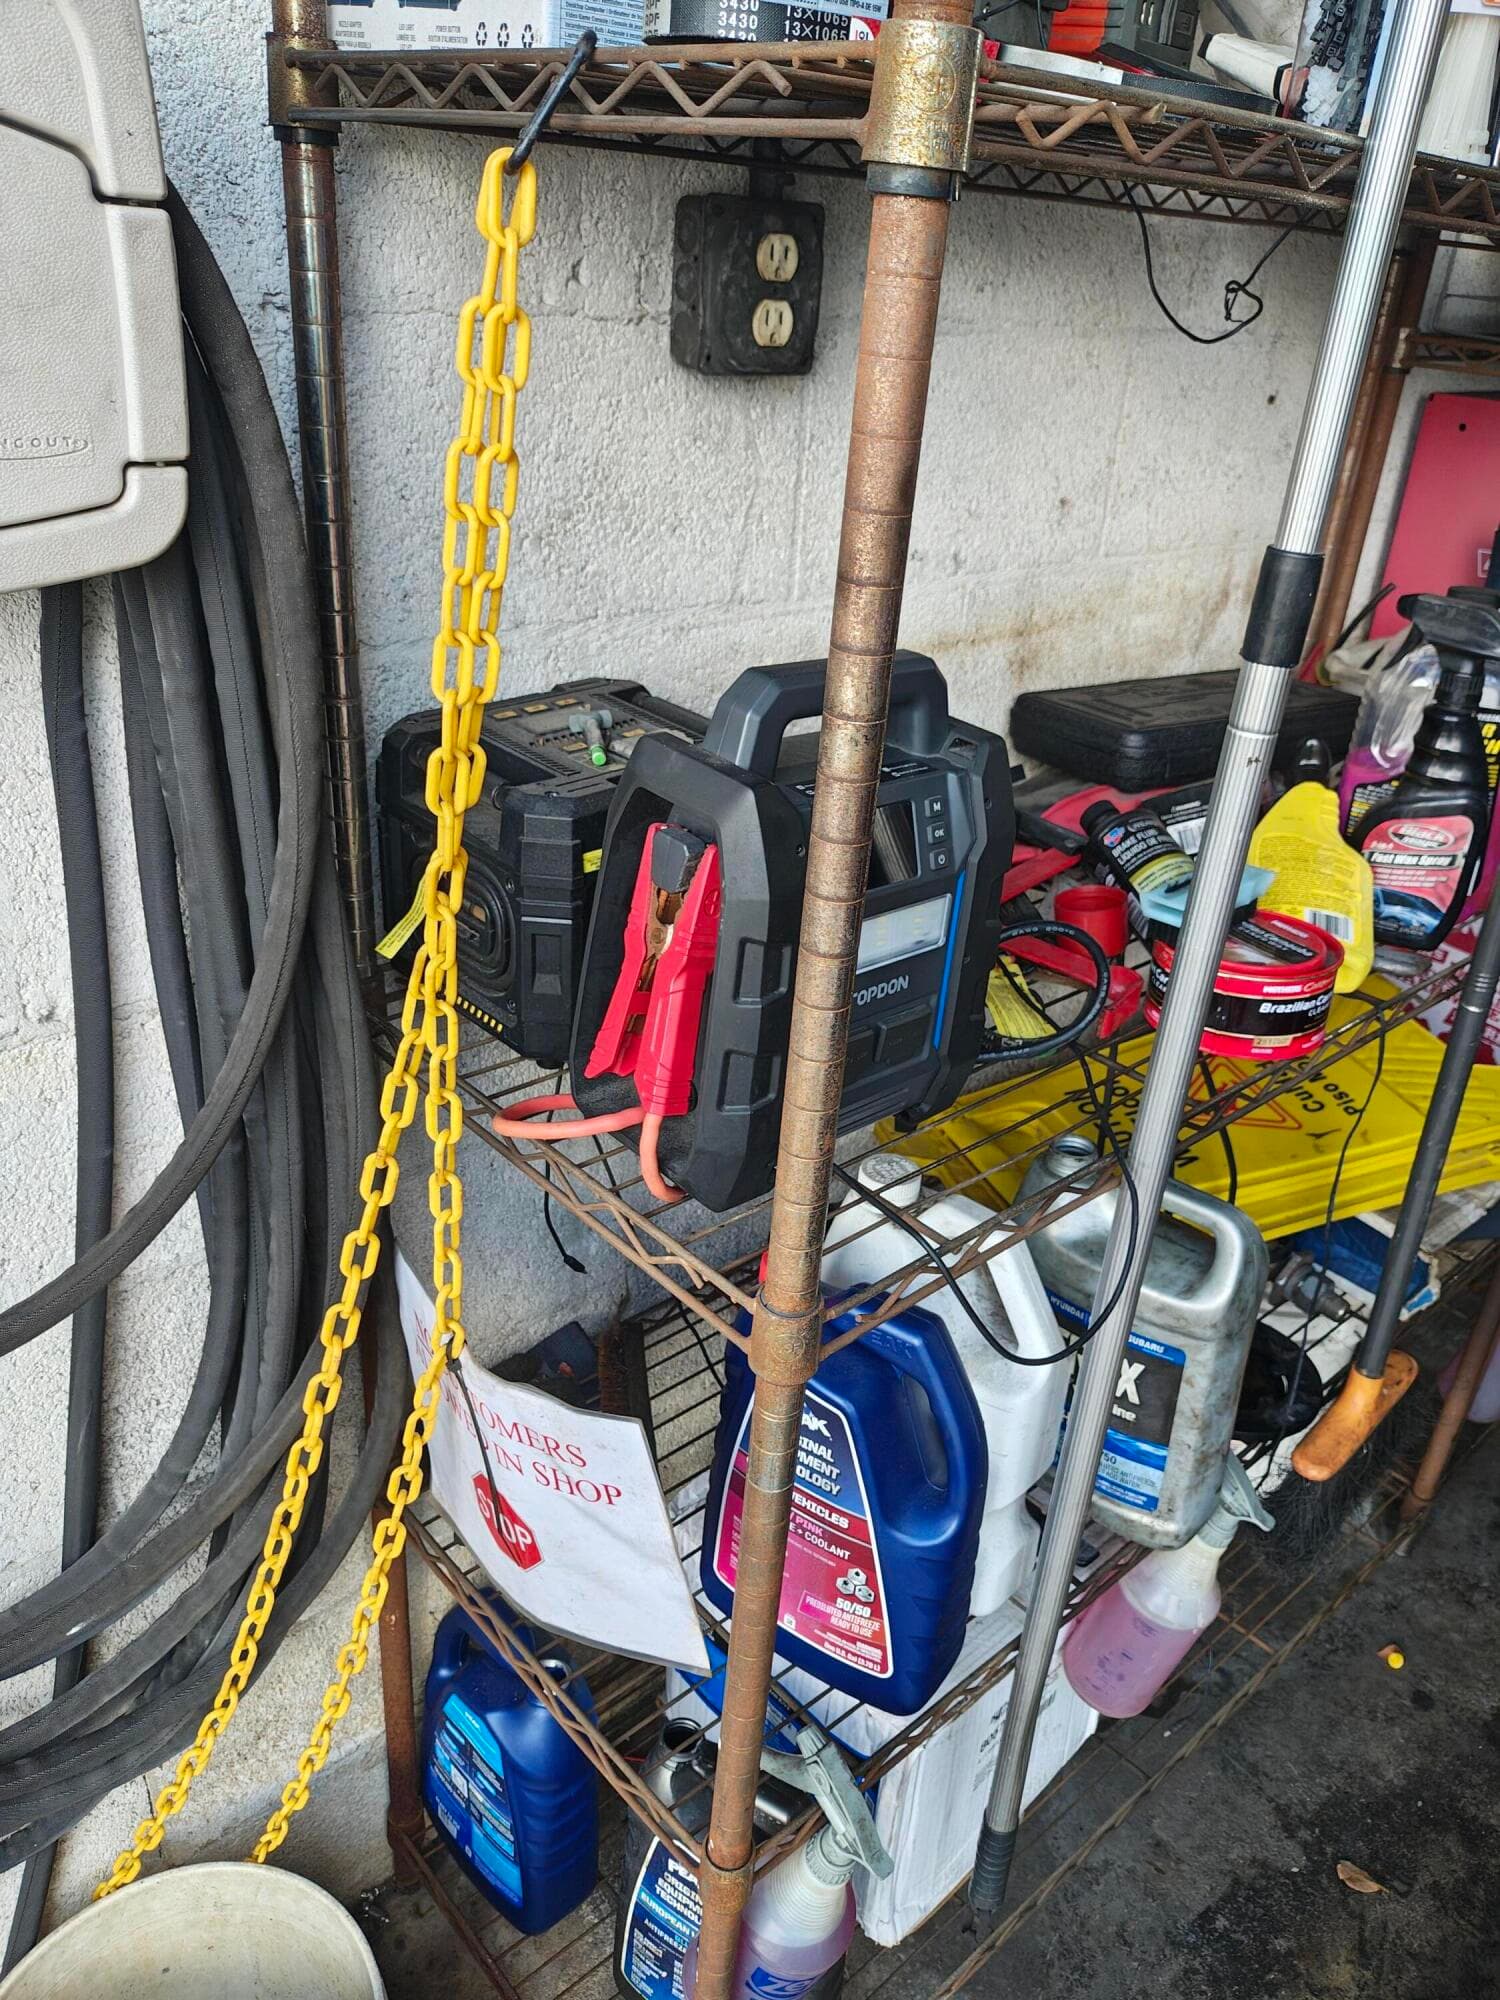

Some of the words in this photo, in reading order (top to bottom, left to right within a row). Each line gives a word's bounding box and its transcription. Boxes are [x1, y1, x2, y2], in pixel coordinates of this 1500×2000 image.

[718, 11, 758, 29] 3430
[784, 20, 848, 41] 13X1065
[933, 801, 941, 812] M
[934, 829, 945, 838] OK
[1258, 999, 1316, 1014] Brazilian
[446, 1370, 587, 1468] TOMERS
[801, 1415, 833, 1438] AK
[799, 1436, 835, 1462] INAL
[495, 1440, 525, 1476] IN
[532, 1461, 623, 1505] SHOP
[795, 1464, 841, 1495] OLOGY
[795, 1513, 824, 1537] PINK
[804, 1531, 851, 1560] COOLANT
[836, 1597, 871, 1618] 50/50
[850, 1622, 859, 1633] TO
[859, 1626, 873, 1638] USE
[668, 1858, 700, 1889] PEA
[658, 1877, 703, 1917] EQUIPM
[664, 1871, 703, 1905] ORIGIN
[640, 1891, 690, 1935] EUROPEAN
[655, 1884, 703, 1926] TECHNOL
